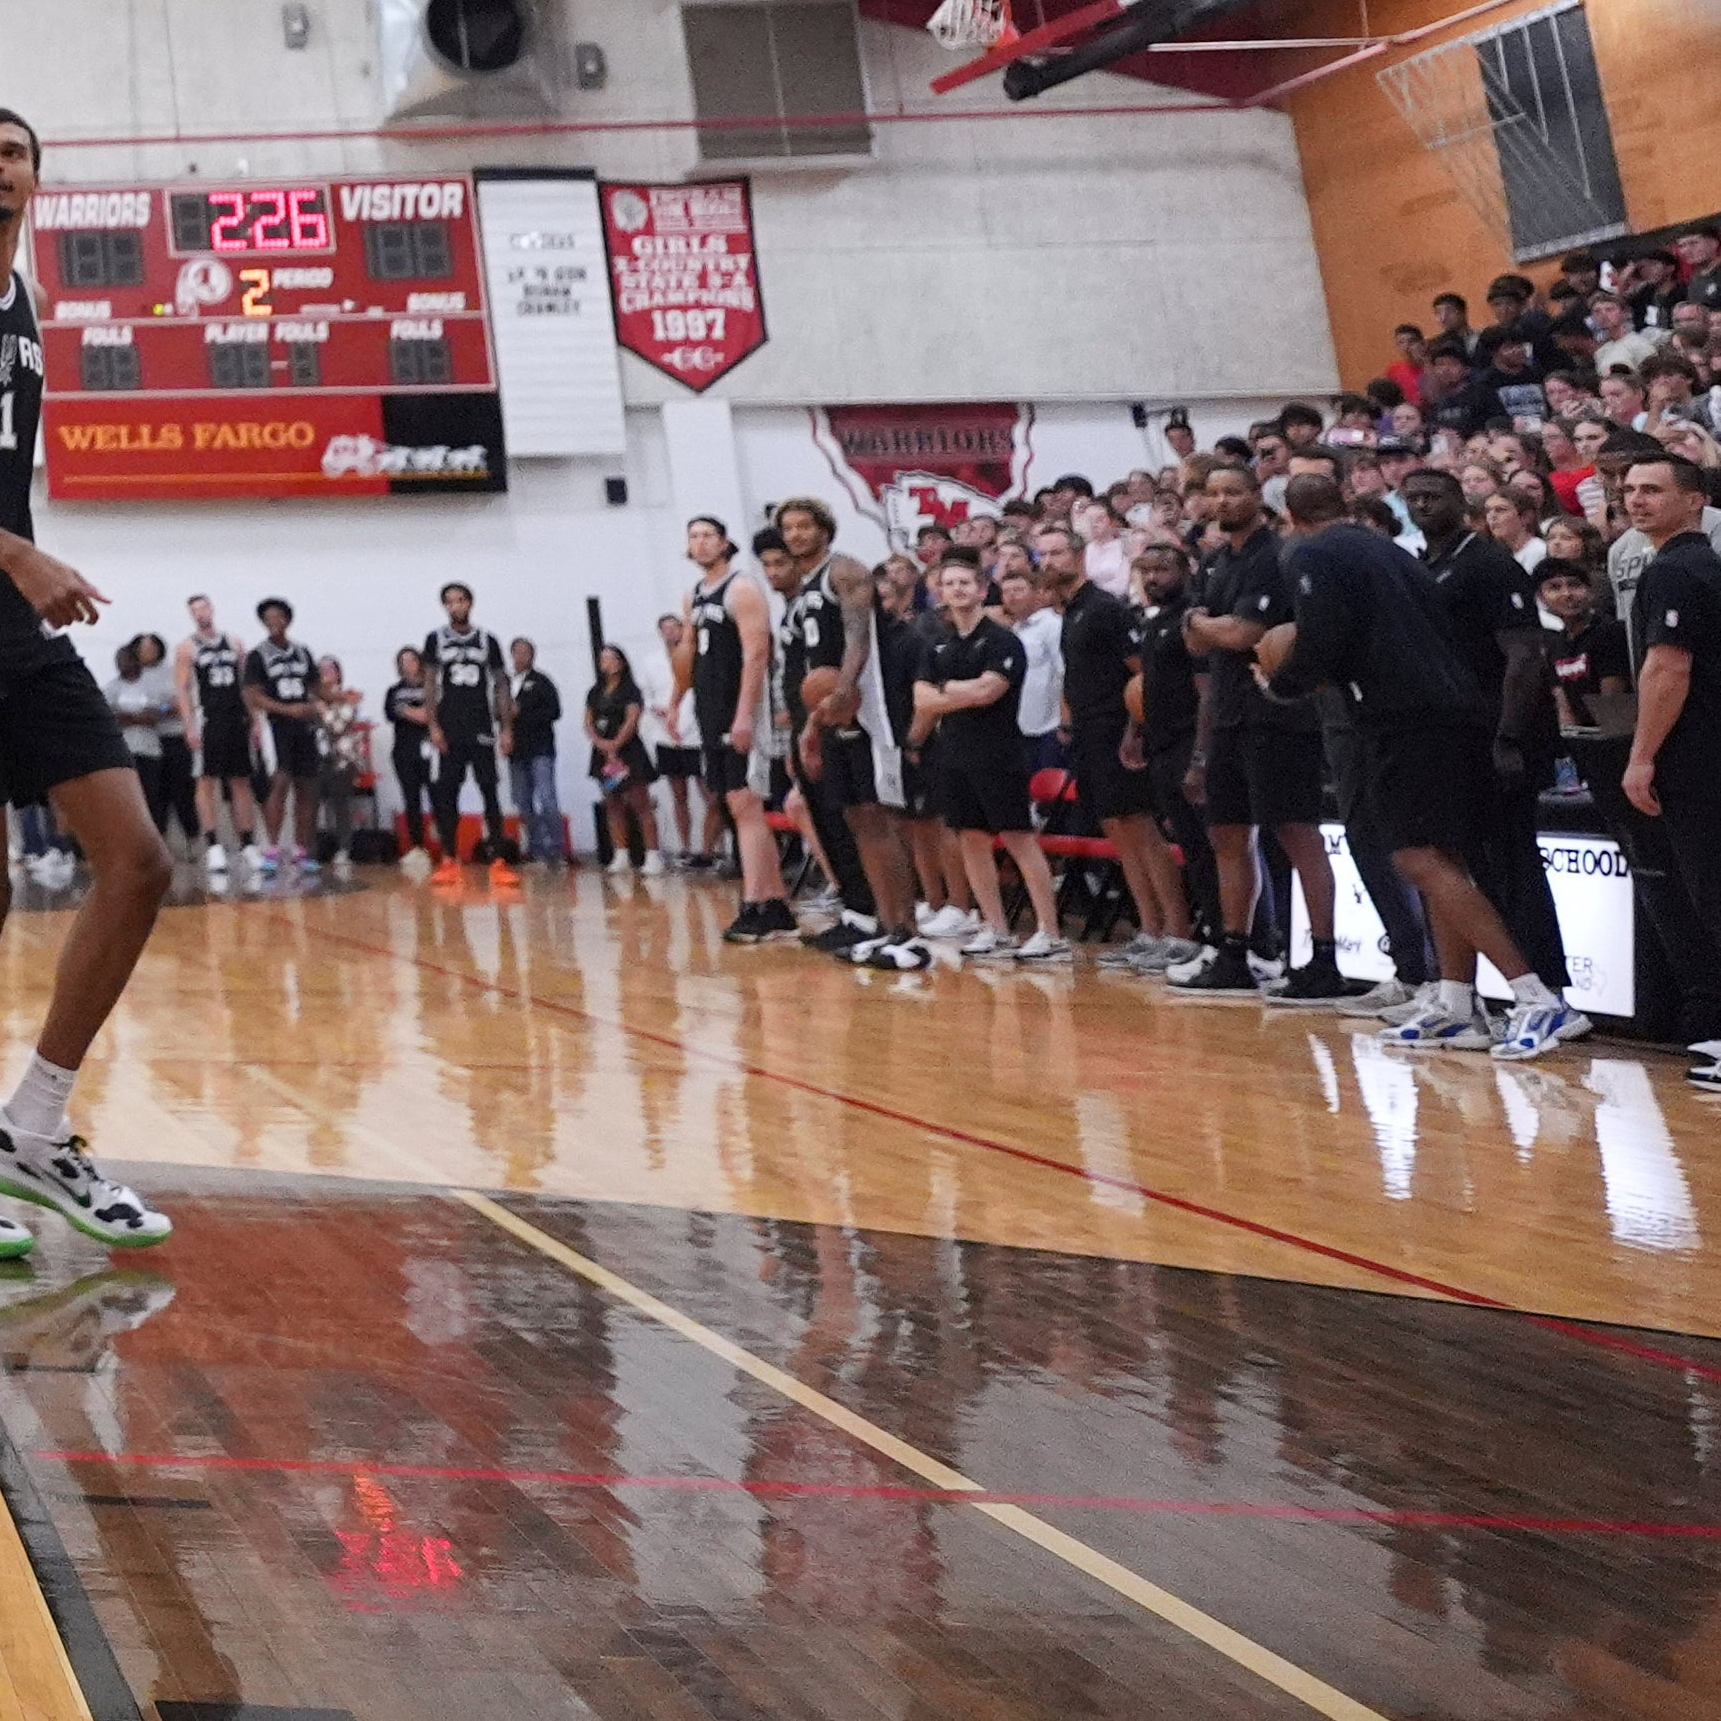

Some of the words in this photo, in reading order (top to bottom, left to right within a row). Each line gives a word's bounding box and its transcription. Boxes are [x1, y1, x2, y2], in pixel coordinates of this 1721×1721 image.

[33, 191, 152, 228] WARRIORS
[340, 183, 464, 221] VISITOR
[631, 234, 728, 255] GIRLS
[272, 267, 333, 289] PERIOD
[239, 268, 272, 317] 2
[81, 326, 133, 345] FOULS
[205, 324, 269, 343] PLAYER
[275, 322, 330, 343] FOULS
[390, 319, 443, 341] FOULS
[60, 424, 184, 451] WELLS
[193, 421, 316, 450] FARGO
[1539, 847, 1628, 877] SCHOOL
